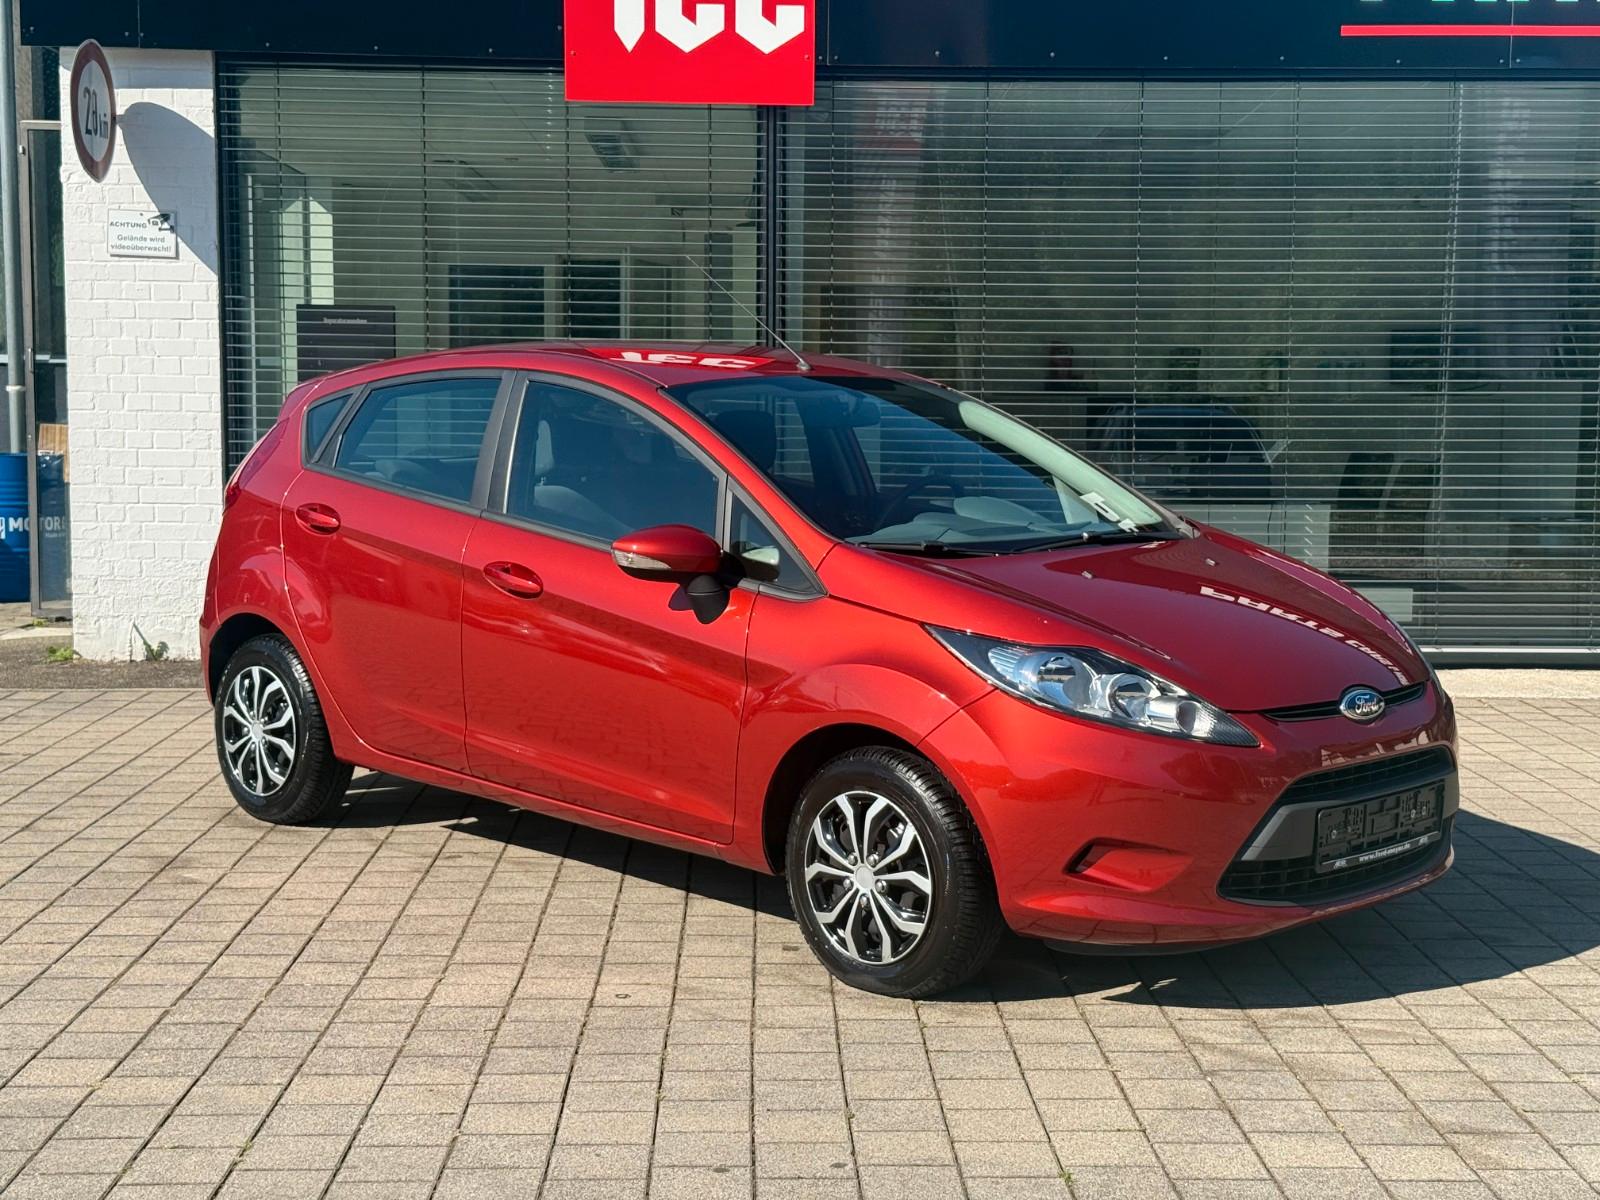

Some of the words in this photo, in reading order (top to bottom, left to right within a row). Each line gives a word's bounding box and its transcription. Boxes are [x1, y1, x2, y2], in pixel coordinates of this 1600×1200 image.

[109, 221, 148, 229] ACHTUNG
[117, 233, 148, 242] Gelände
[110, 243, 172, 252] videoüberwacht!
[1355, 695, 1379, 714] Ford
